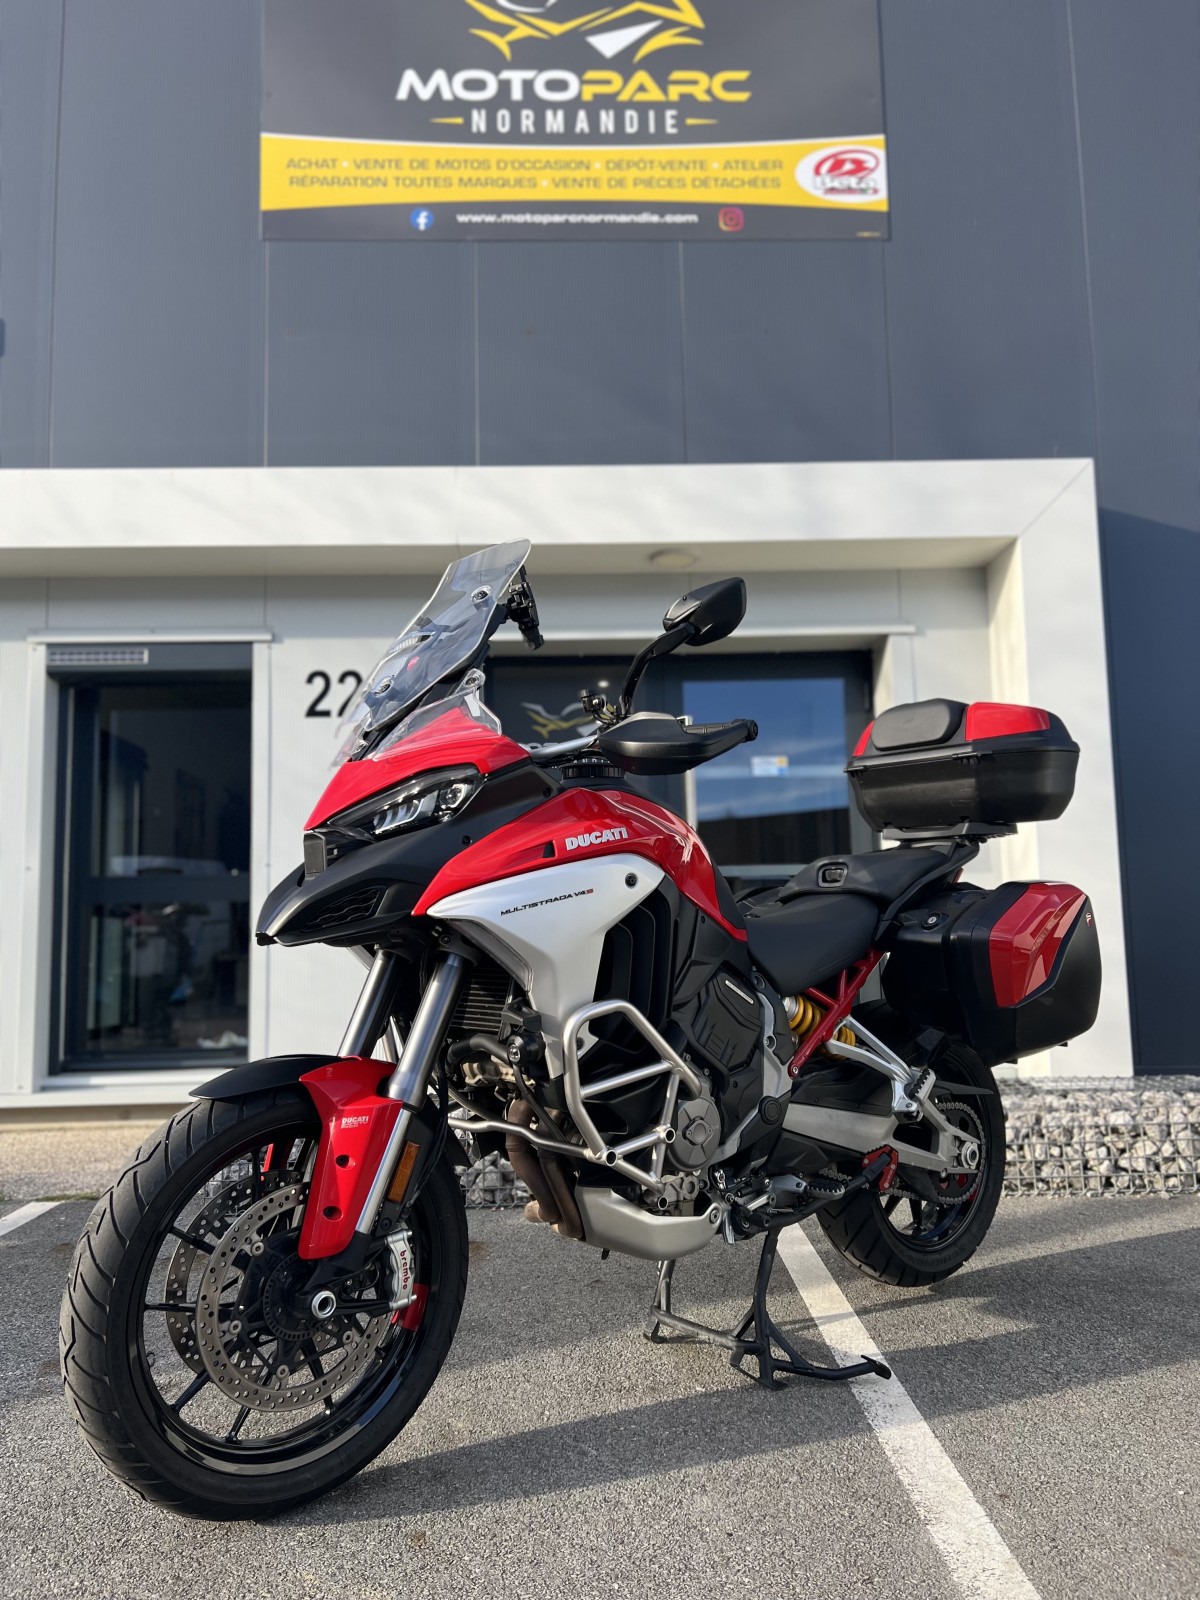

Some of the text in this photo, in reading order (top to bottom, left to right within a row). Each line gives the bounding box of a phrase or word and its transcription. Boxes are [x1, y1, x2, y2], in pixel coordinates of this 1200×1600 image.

[396, 69, 752, 102] MOTOPARC
[471, 109, 679, 134] NORMANDIE
[286, 158, 338, 171] ACHAT
[353, 158, 404, 171] VENTE
[409, 158, 430, 171] DE
[435, 158, 491, 171] MOTOS
[496, 158, 591, 172] D'OCCASION
[723, 158, 783, 171] ATELIER
[289, 174, 388, 188] RÉPARATION
[394, 175, 453, 188] TOUTES
[458, 175, 538, 189] MARQUES
[552, 176, 602, 189] VENTE
[607, 176, 628, 189] DE
[691, 174, 781, 189] DÉTACHÉES
[455, 212, 699, 225] www.motoparcnormandie.com
[565, 827, 628, 851] DUCATI
[500, 892, 573, 916] MULTISTRADA
[342, 1115, 369, 1124] DUCATI
[400, 1249, 410, 1290] brembo
